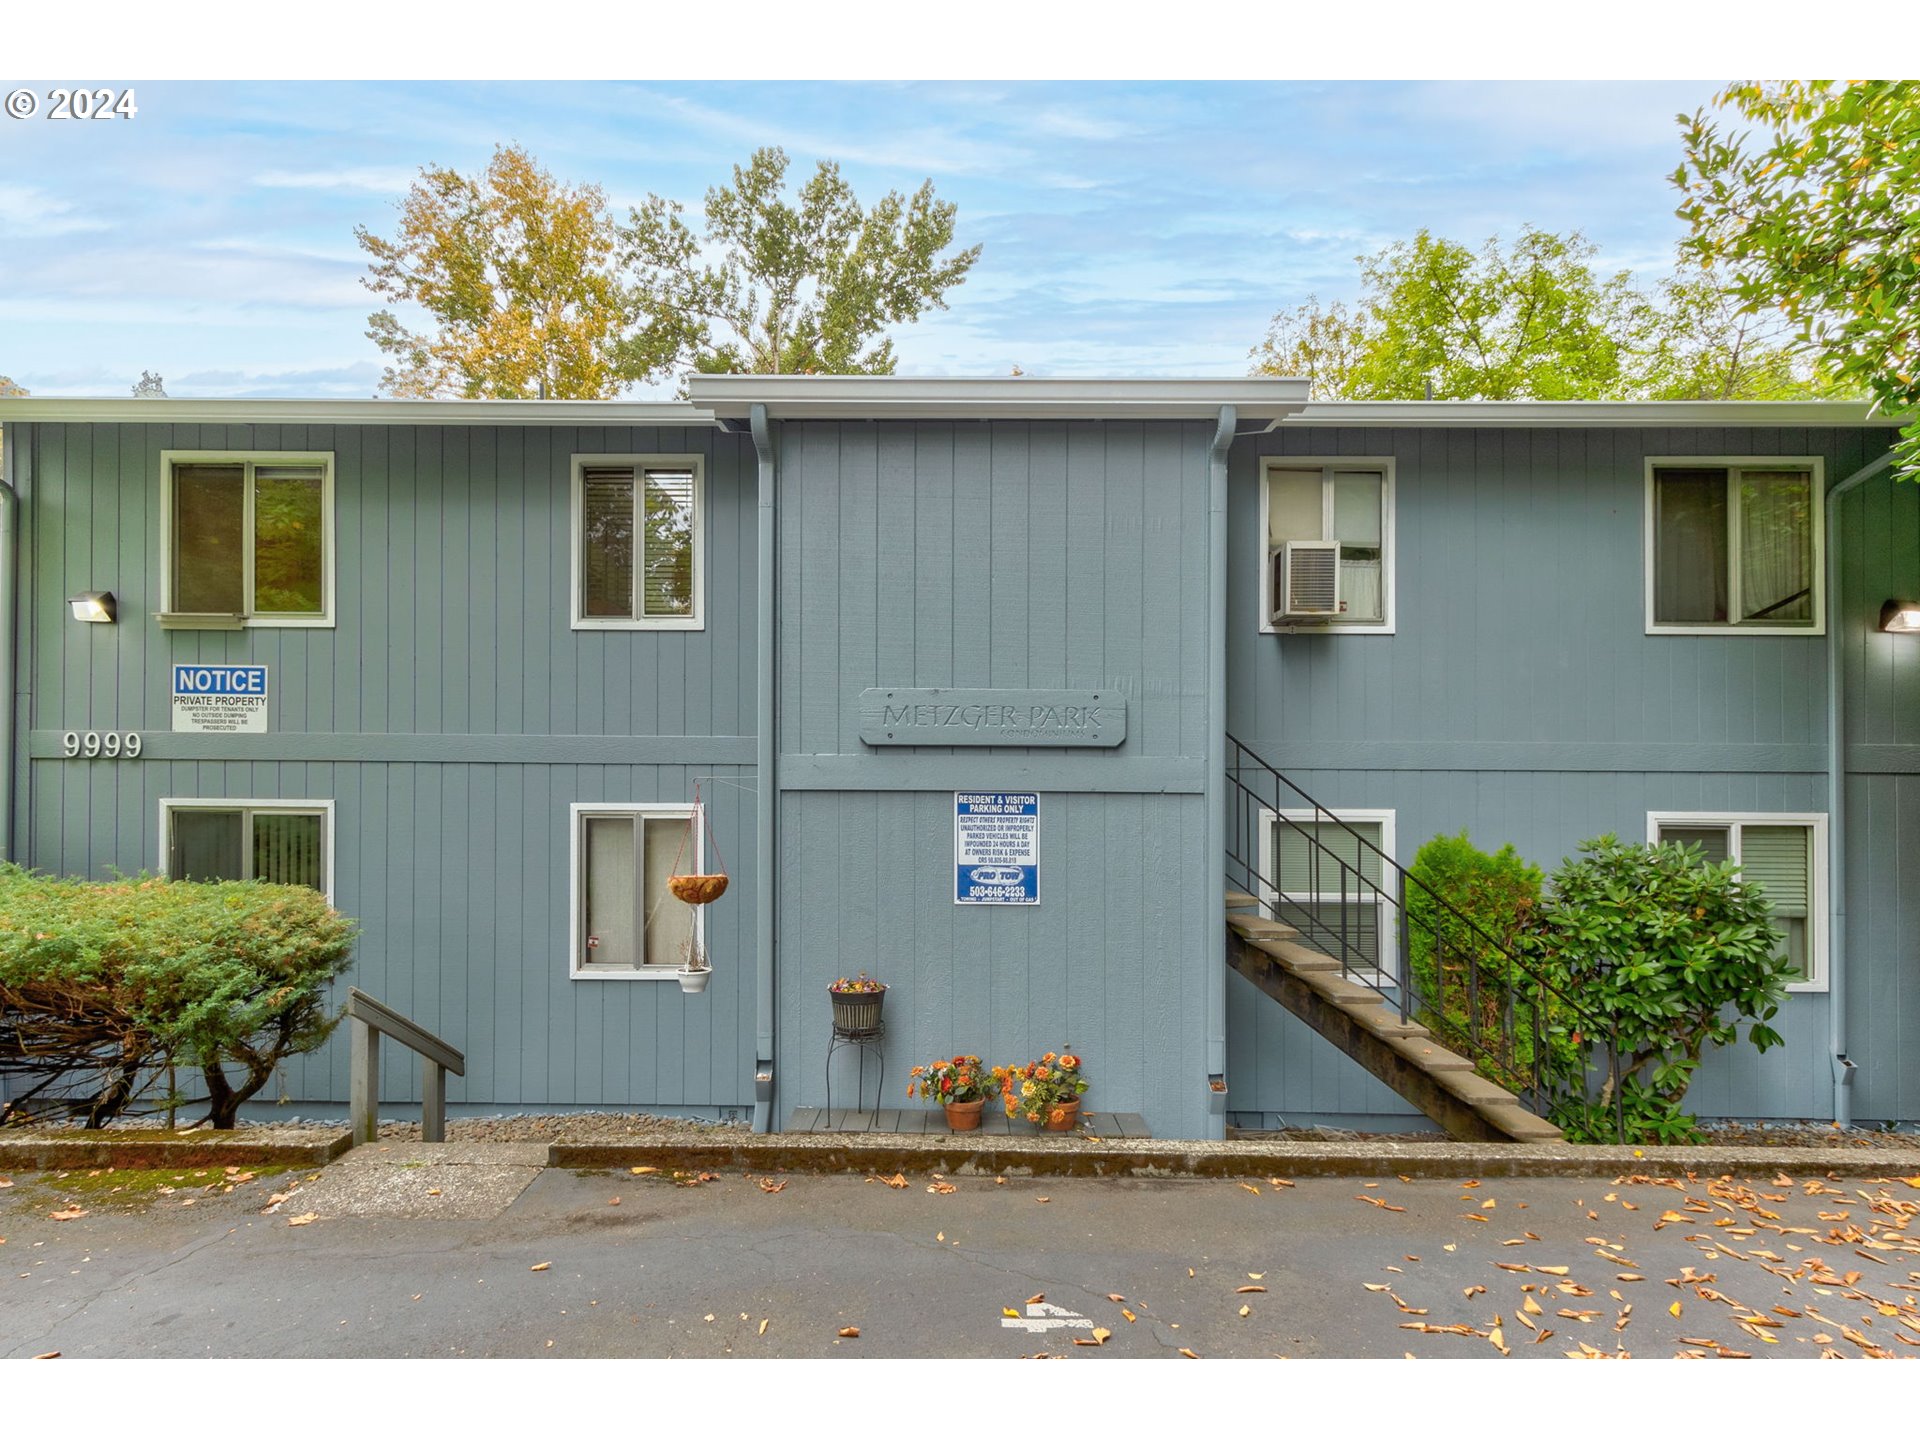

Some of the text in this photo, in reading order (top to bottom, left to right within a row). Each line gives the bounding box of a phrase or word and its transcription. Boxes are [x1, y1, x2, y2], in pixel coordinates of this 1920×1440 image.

[180, 669, 261, 691] NOTICE
[174, 696, 266, 706] PRIVATE PROPERTY
[883, 704, 1102, 731] METZGER PARK
[63, 732, 141, 757] 9999
[958, 795, 1035, 804] RESIDENT & VISITOR
[970, 804, 1024, 813] PARKING ONLY
[978, 872, 1020, 880] PRO TOW
[970, 886, 1025, 897] 503-646-2233
